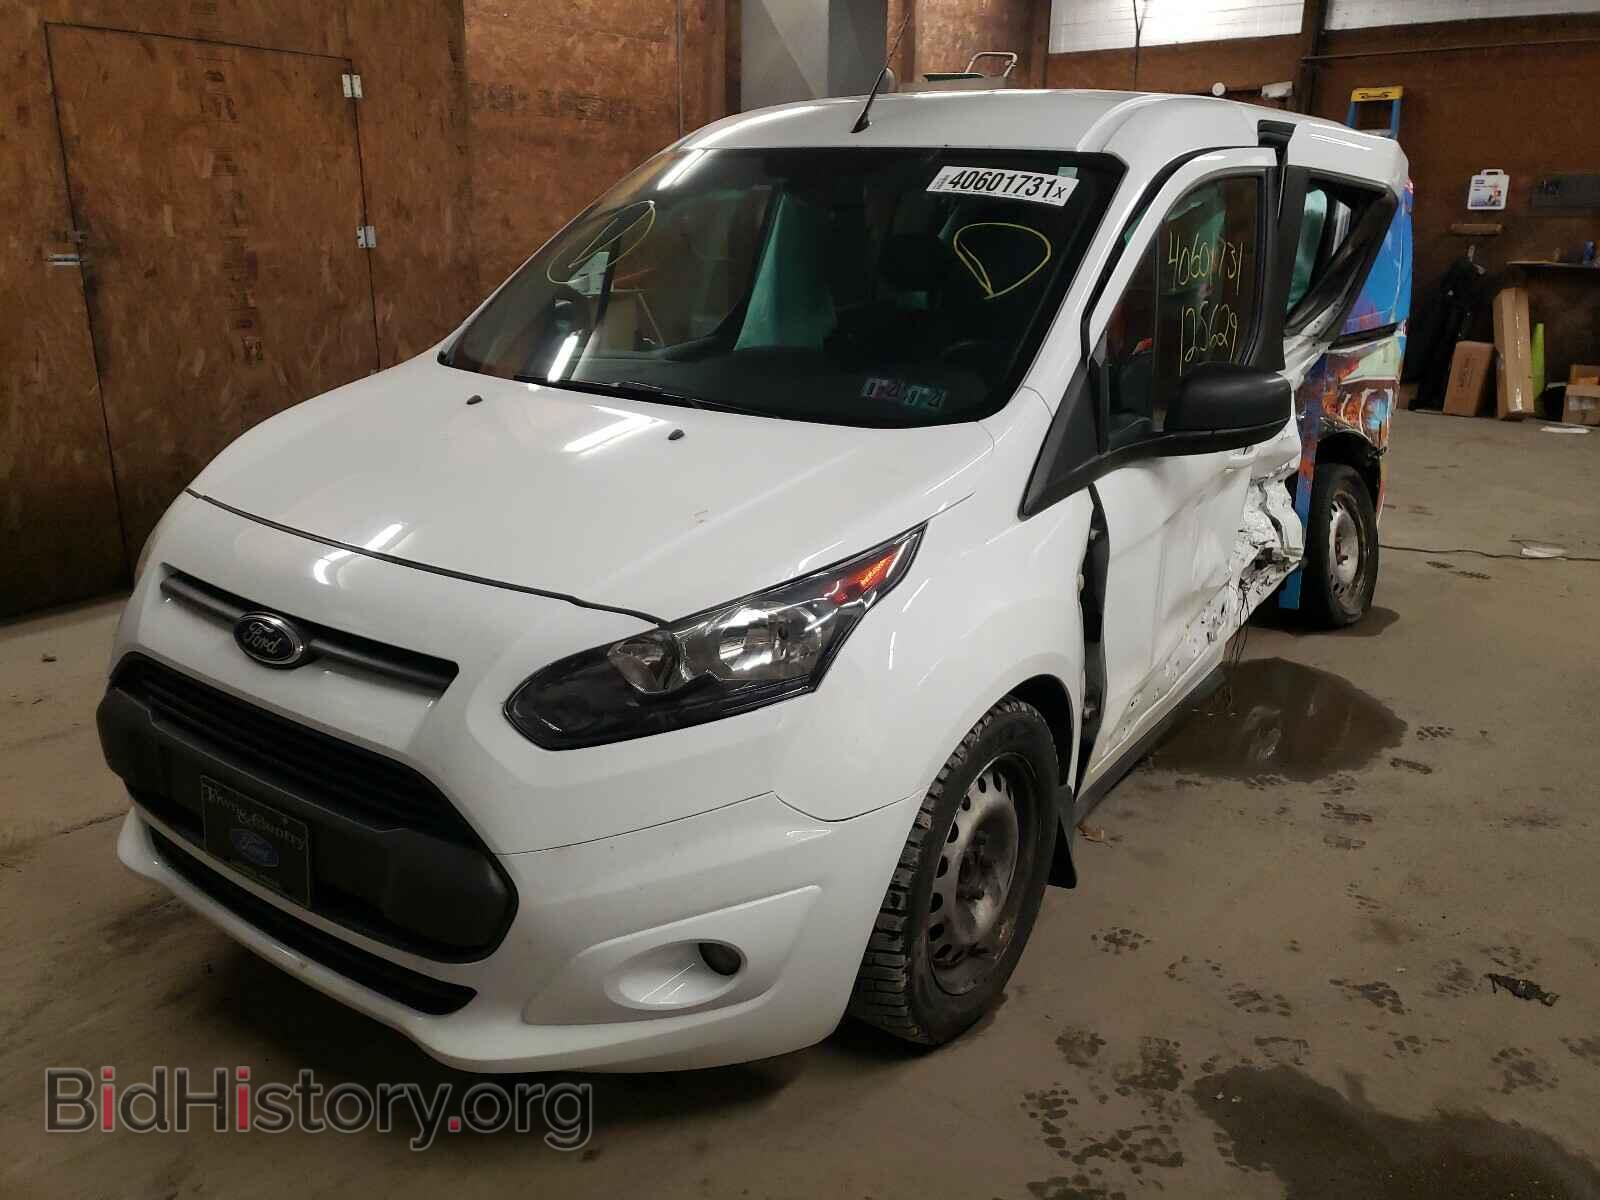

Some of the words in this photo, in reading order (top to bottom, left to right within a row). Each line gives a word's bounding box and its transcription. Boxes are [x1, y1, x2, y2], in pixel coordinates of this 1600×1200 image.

[1168, 231, 1244, 296] 40601731
[1179, 300, 1238, 376] 125629
[243, 621, 282, 654] Ford
